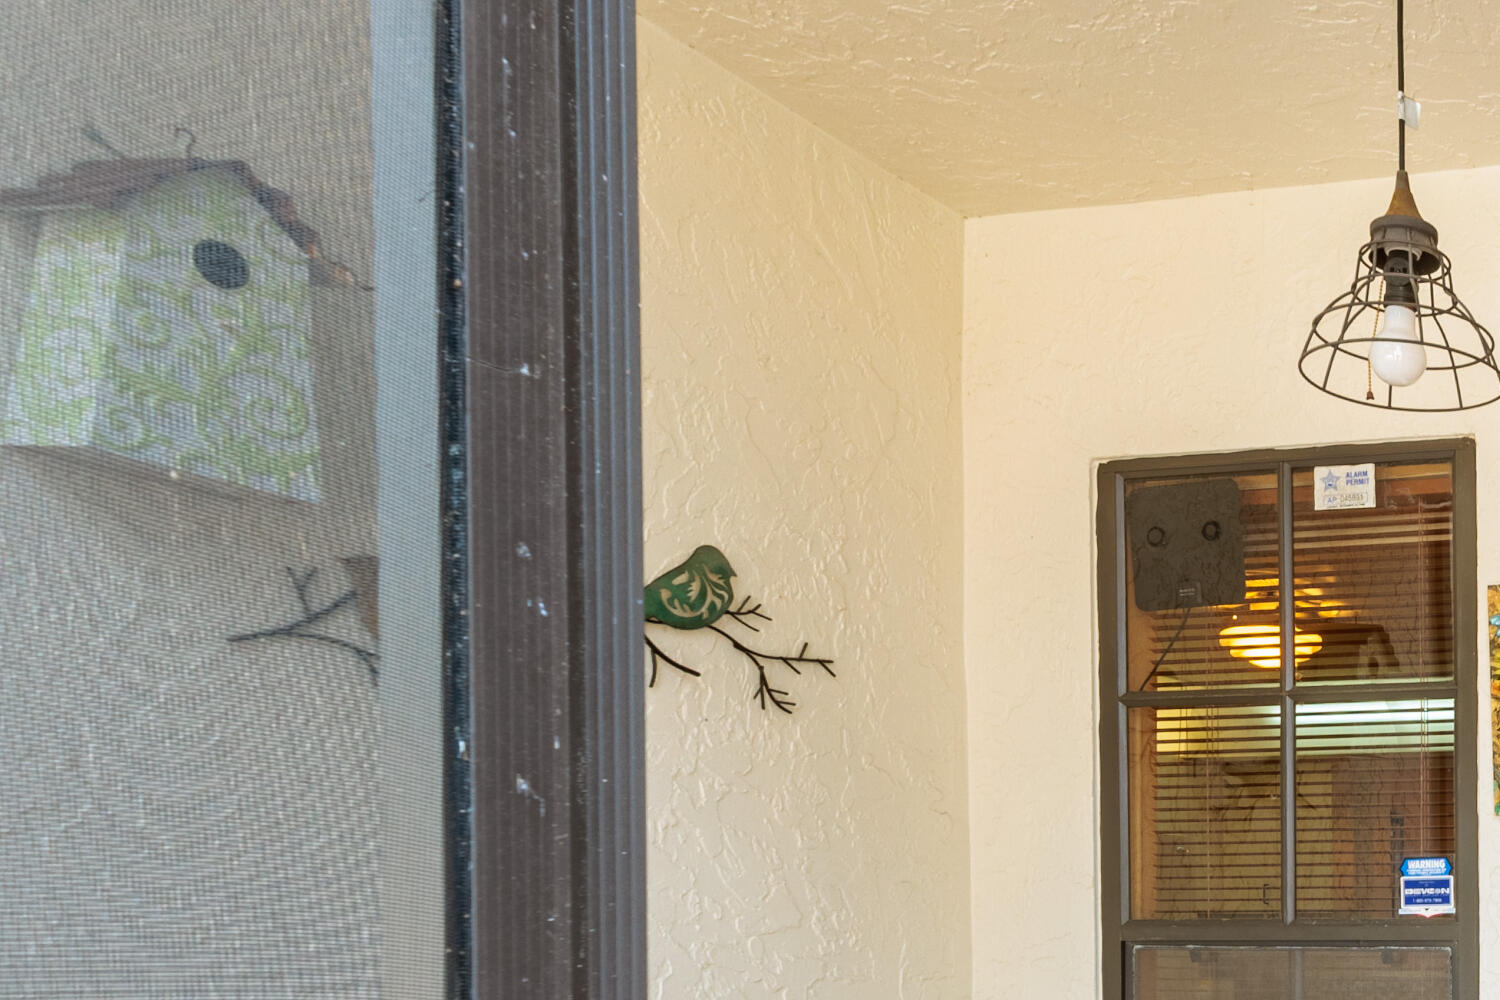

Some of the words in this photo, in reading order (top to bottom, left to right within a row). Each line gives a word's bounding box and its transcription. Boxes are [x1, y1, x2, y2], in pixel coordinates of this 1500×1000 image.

[1345, 470, 1368, 478] ALARM
[1346, 478, 1370, 486] PERMIT
[1407, 858, 1446, 869] WARNING
